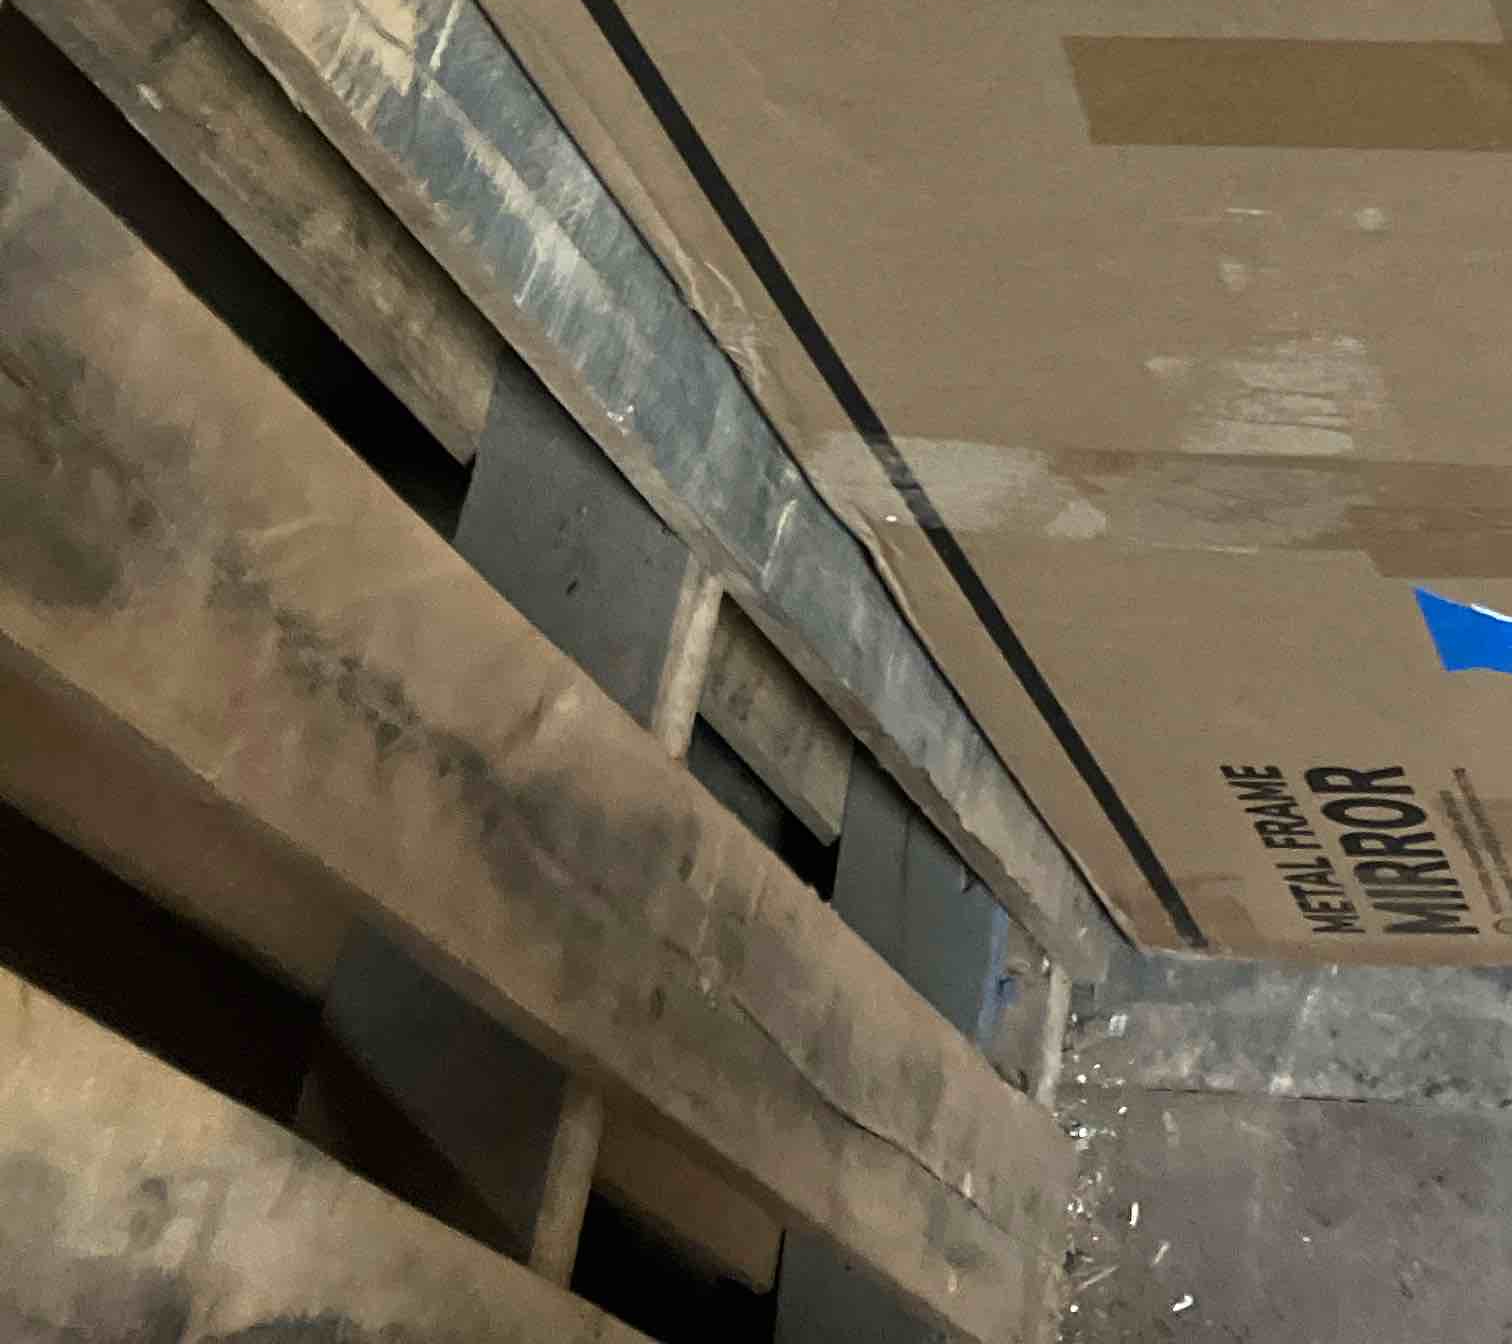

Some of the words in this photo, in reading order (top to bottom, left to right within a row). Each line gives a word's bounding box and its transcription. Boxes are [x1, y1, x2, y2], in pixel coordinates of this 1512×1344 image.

[1219, 764, 1323, 850] FRAME
[1303, 765, 1481, 936] MIRROR
[1275, 855, 1367, 935] METAL
